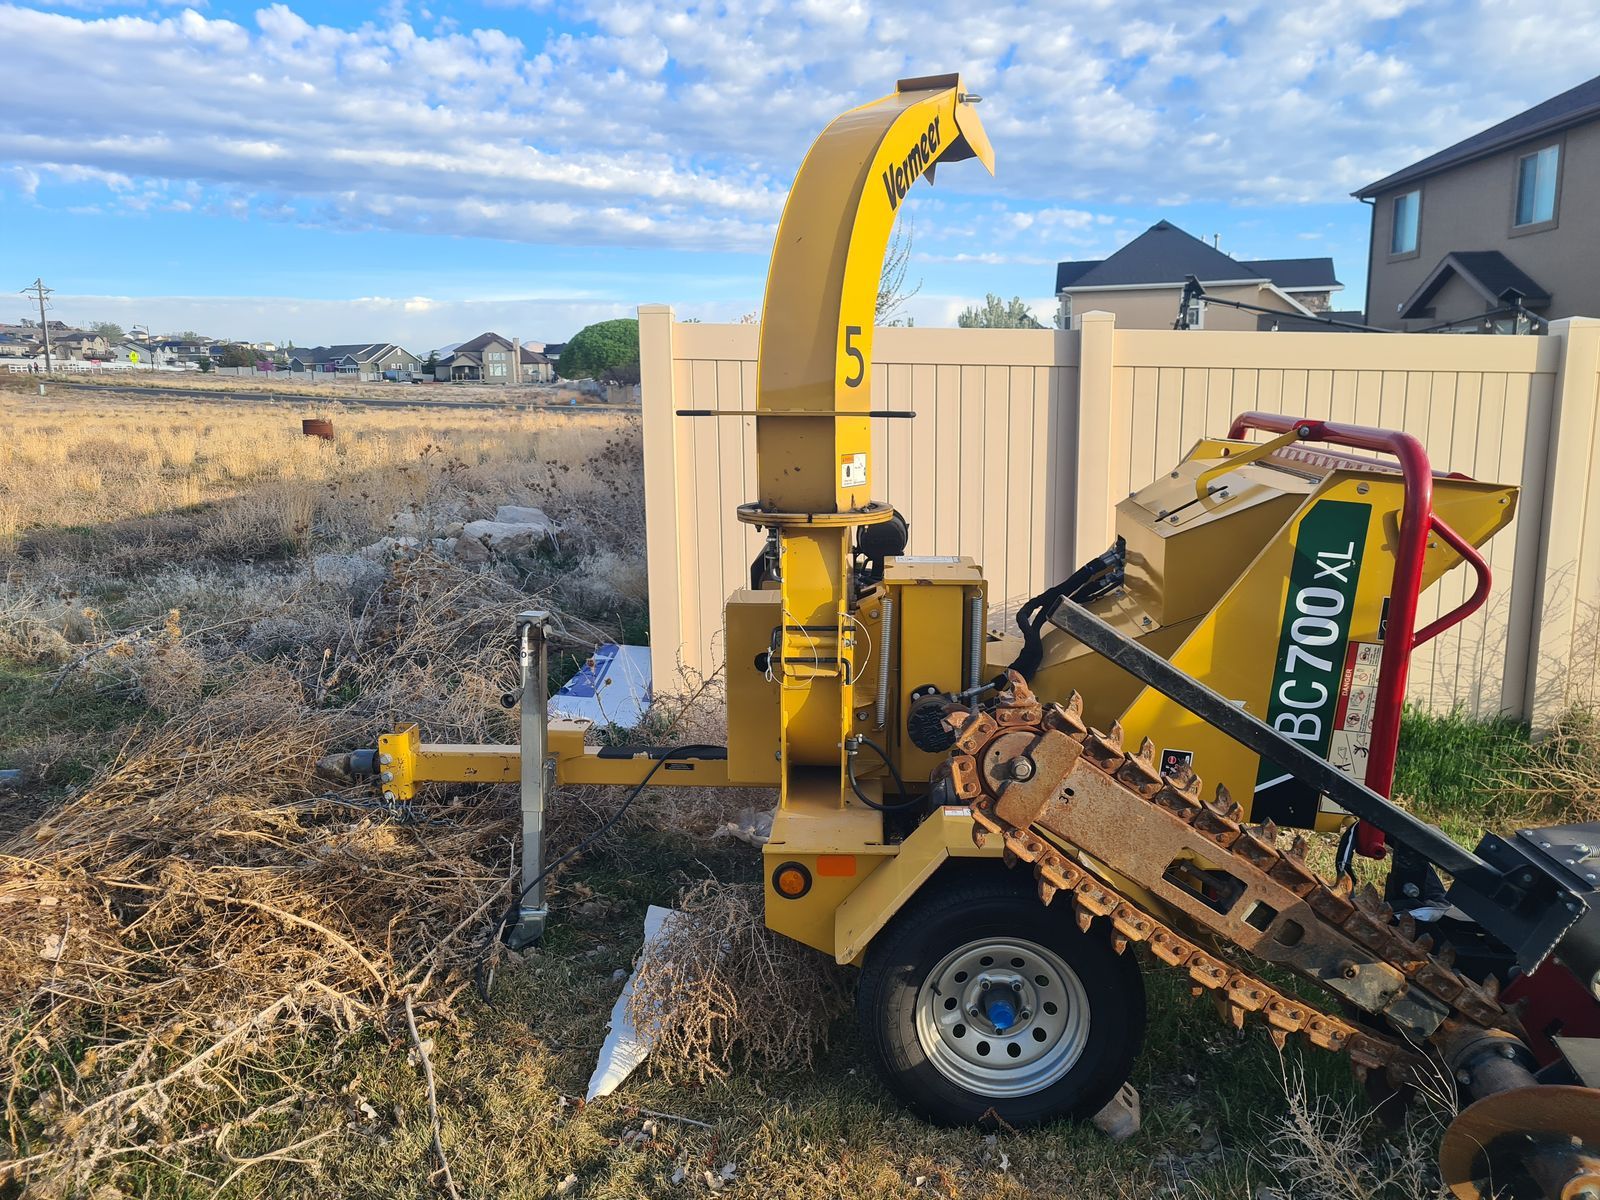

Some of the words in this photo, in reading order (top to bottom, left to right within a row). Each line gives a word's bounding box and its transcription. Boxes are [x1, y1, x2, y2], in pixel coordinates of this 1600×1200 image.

[882, 114, 940, 211] Vermeer
[845, 325, 865, 388] 5
[1341, 668, 1353, 697] DANGER
